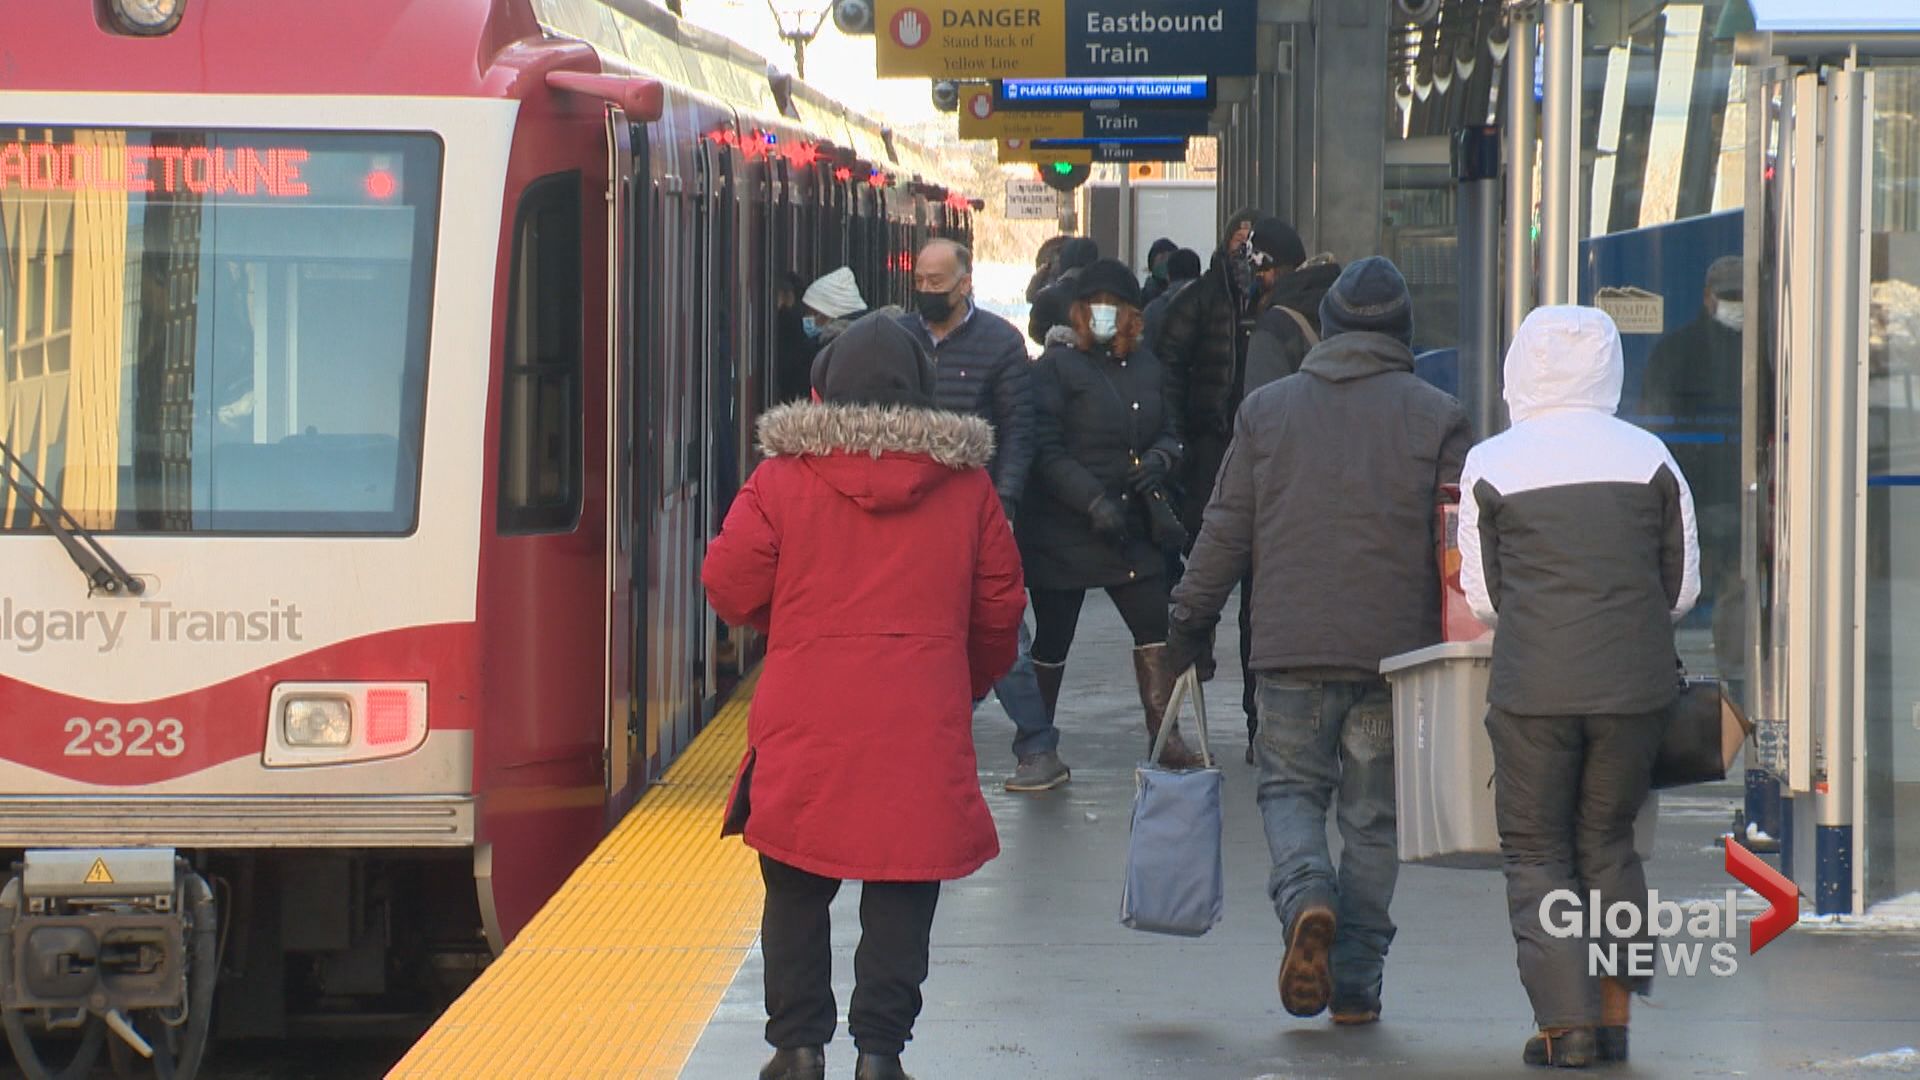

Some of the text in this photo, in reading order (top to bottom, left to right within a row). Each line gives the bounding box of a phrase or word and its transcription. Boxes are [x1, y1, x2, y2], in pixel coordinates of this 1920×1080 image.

[943, 8, 1041, 28] DANGER
[1087, 9, 1223, 33] Eastbound
[943, 34, 1034, 48] Stand Back of
[1086, 42, 1149, 64] Train
[944, 57, 1019, 70] Yellow Line
[1020, 85, 1192, 96] PLEASE STAND BEHIND THE YELLOW LINE
[1096, 114, 1138, 129] Train
[1103, 147, 1133, 158] Train
[0, 597, 303, 652] lgary Transit
[64, 717, 185, 757] 2323
